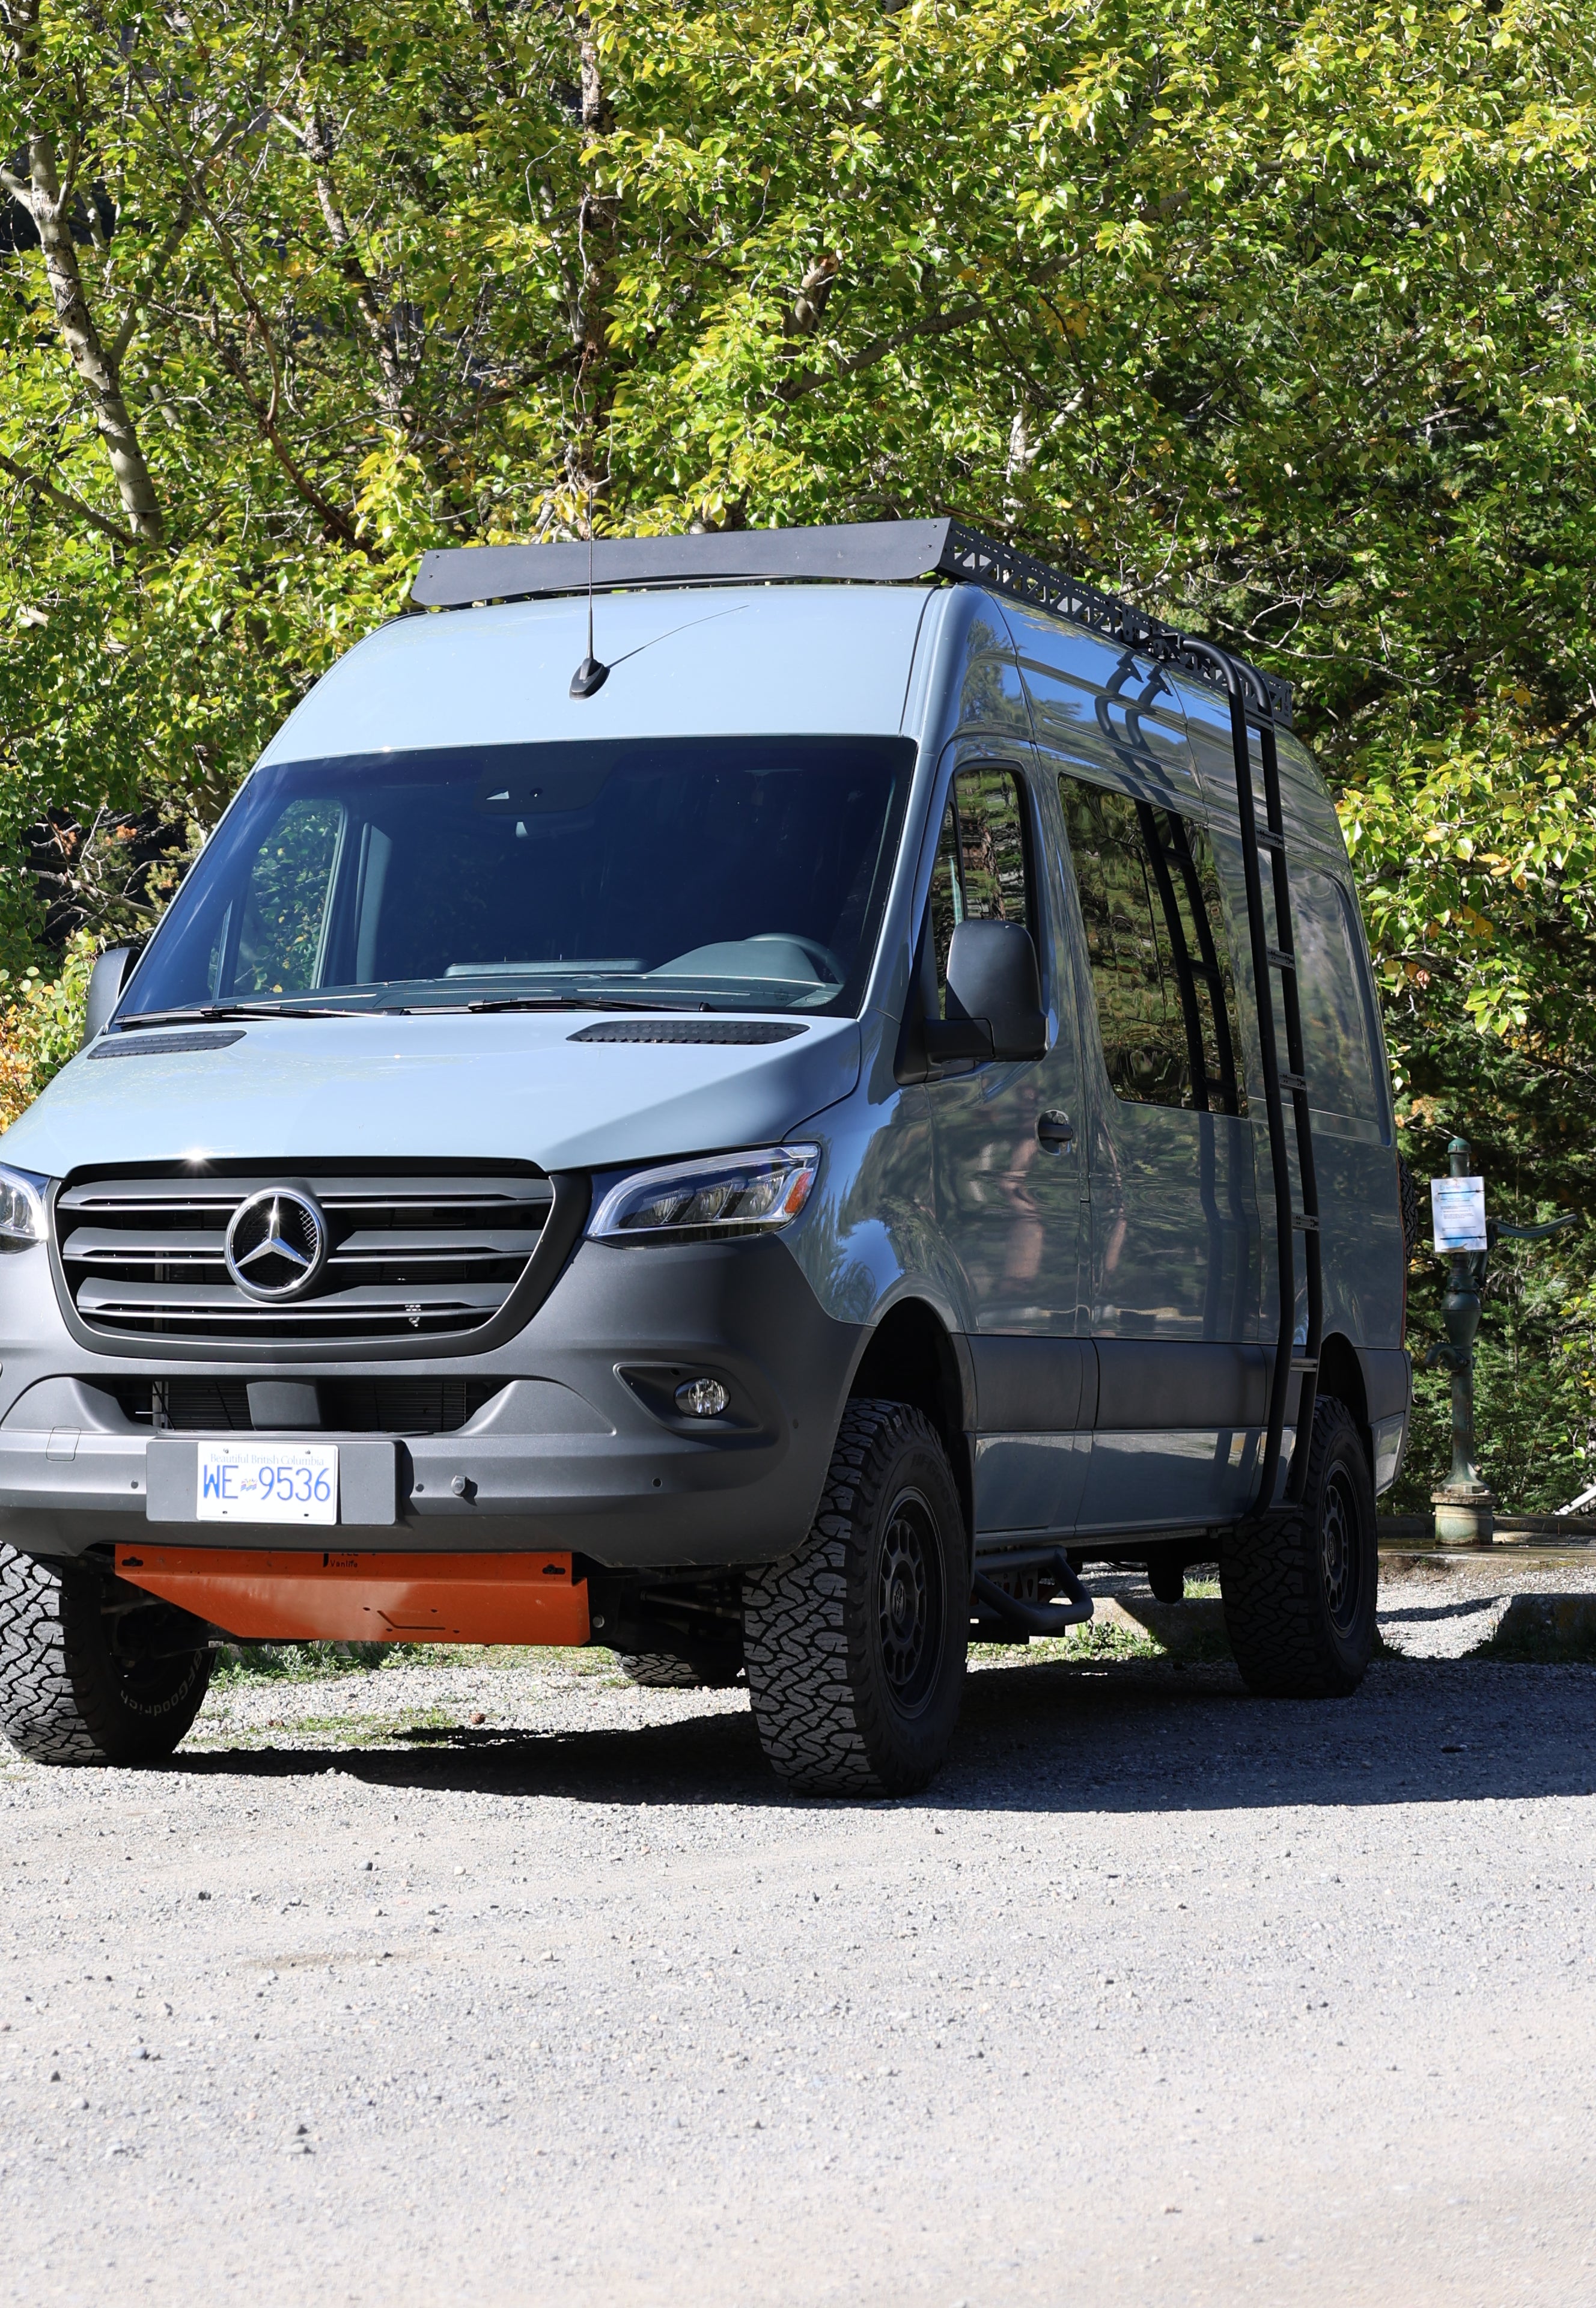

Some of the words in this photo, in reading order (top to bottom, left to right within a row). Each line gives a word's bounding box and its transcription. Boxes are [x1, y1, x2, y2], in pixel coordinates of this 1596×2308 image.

[210, 1453, 249, 1464] Beautiful
[251, 1454, 279, 1464] British
[281, 1455, 324, 1466] Columbia
[204, 1465, 239, 1500] WE
[258, 1466, 331, 1502] 9536
[120, 1649, 203, 1717] BFGoodrich
